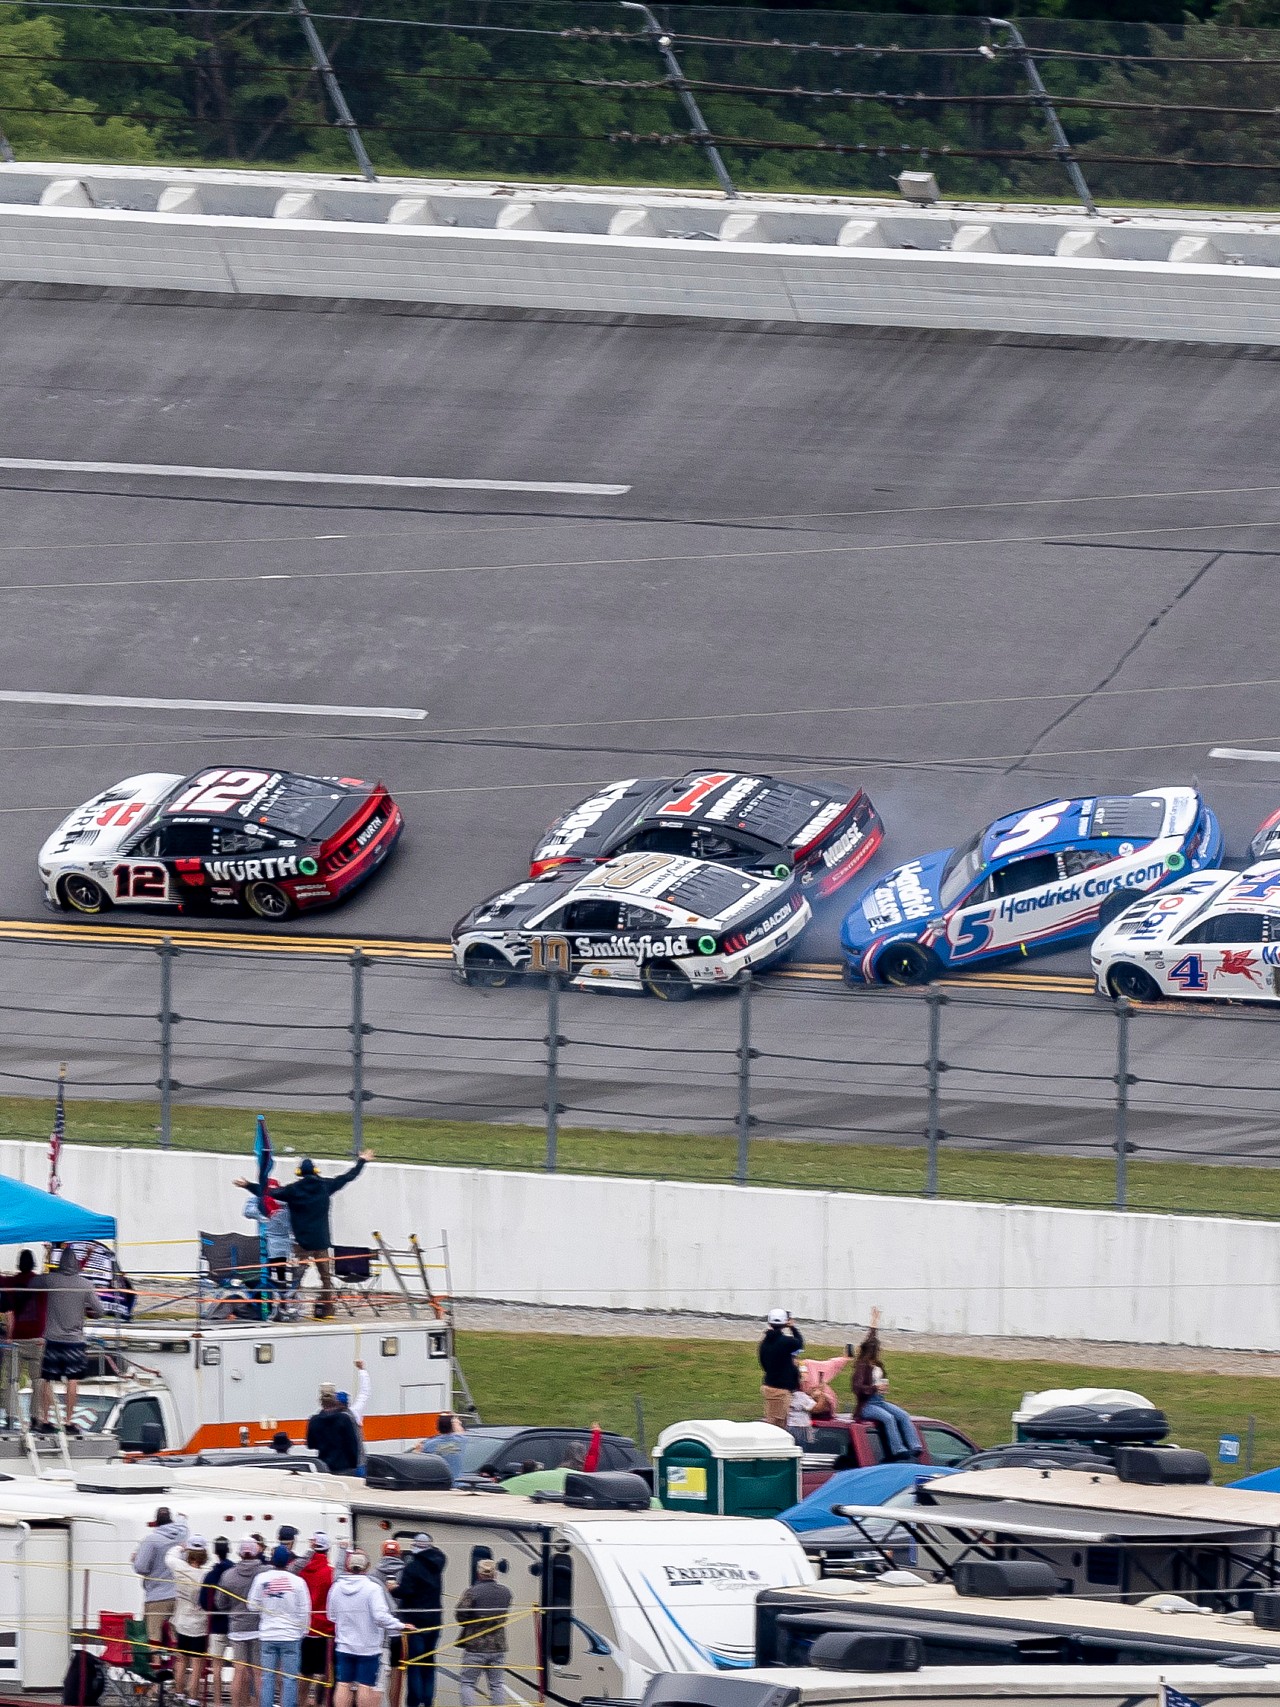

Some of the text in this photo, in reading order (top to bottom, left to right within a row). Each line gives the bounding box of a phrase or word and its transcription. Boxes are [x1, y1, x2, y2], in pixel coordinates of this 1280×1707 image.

[167, 770, 270, 813] 12
[656, 773, 736, 817] 1
[703, 777, 763, 821] MOOSE
[791, 802, 847, 846] MOOSE
[823, 821, 864, 868] MOOSE
[990, 800, 1071, 859] 5
[113, 865, 168, 899] 12
[762, 904, 792, 933] BACON
[949, 908, 998, 959] 5
[575, 935, 693, 966] Smithfield
[1167, 953, 1208, 990] 4
[661, 1566, 746, 1580] FREEDOM
